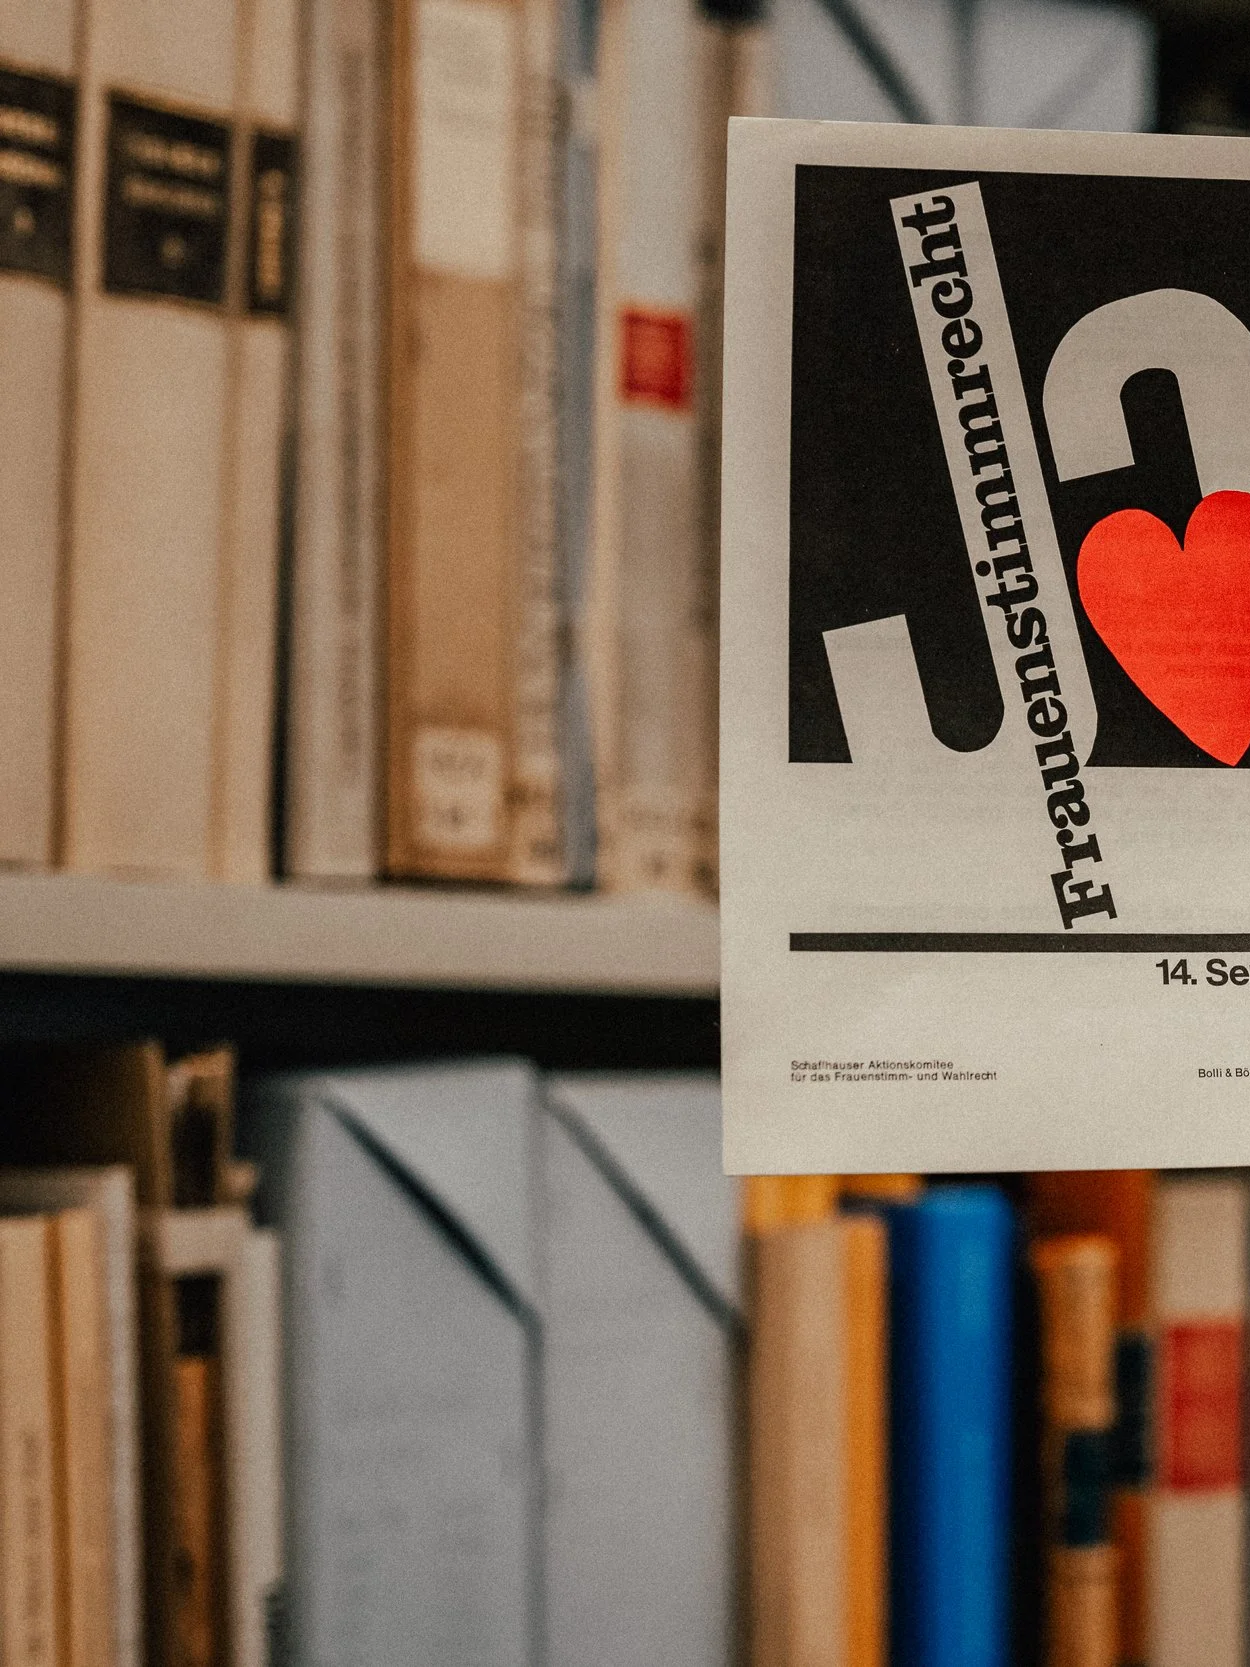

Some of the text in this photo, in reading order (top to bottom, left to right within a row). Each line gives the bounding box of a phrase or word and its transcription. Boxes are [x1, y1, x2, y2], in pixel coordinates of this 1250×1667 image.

[902, 194, 1117, 930] Frauenstimmrecht
[1155, 958, 1197, 985] 14.
[868, 1060, 954, 1070] Aktionskomitee
[790, 1071, 998, 1082] für das Frauenstimm- und Wahlrecht
[1198, 1068, 1222, 1078] Bolli
[1225, 1068, 1232, 1077] &
